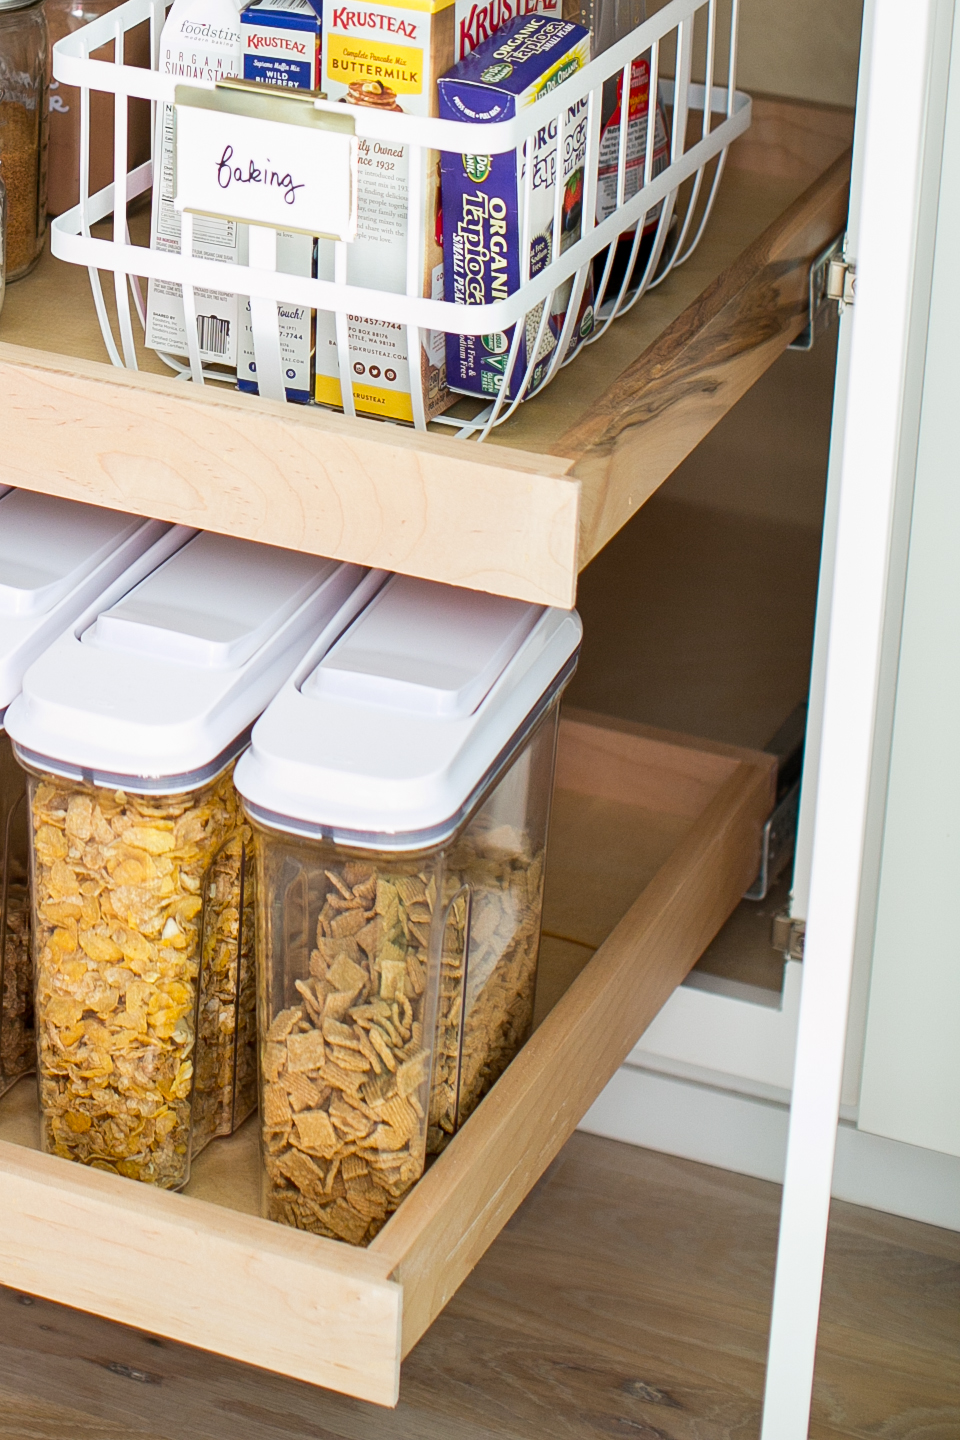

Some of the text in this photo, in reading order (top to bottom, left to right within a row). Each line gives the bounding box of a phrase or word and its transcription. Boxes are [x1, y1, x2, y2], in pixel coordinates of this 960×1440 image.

[332, 6, 417, 40] KRUSTEAZ
[247, 34, 306, 55] KRUSTEAZ
[493, 18, 546, 59] ORGANIC
[165, 61, 204, 79] SUNDAY
[266, 70, 289, 80] WILD
[332, 58, 418, 83] BUTTERMILK
[373, 142, 404, 158] Owned
[376, 160, 395, 171] 1932
[215, 145, 305, 204] baking
[364, 169, 395, 181] introduced
[378, 181, 389, 189] mix
[368, 199, 387, 208] people
[368, 235, 378, 243] you
[380, 227, 394, 236] with
[395, 229, 404, 237] the
[452, 233, 465, 273] SMALL
[489, 197, 508, 304] ORGANI
[277, 306, 305, 320] Touch!
[358, 328, 371, 336] BOX
[459, 334, 467, 359] odium
[467, 335, 477, 377] Fat Free &
